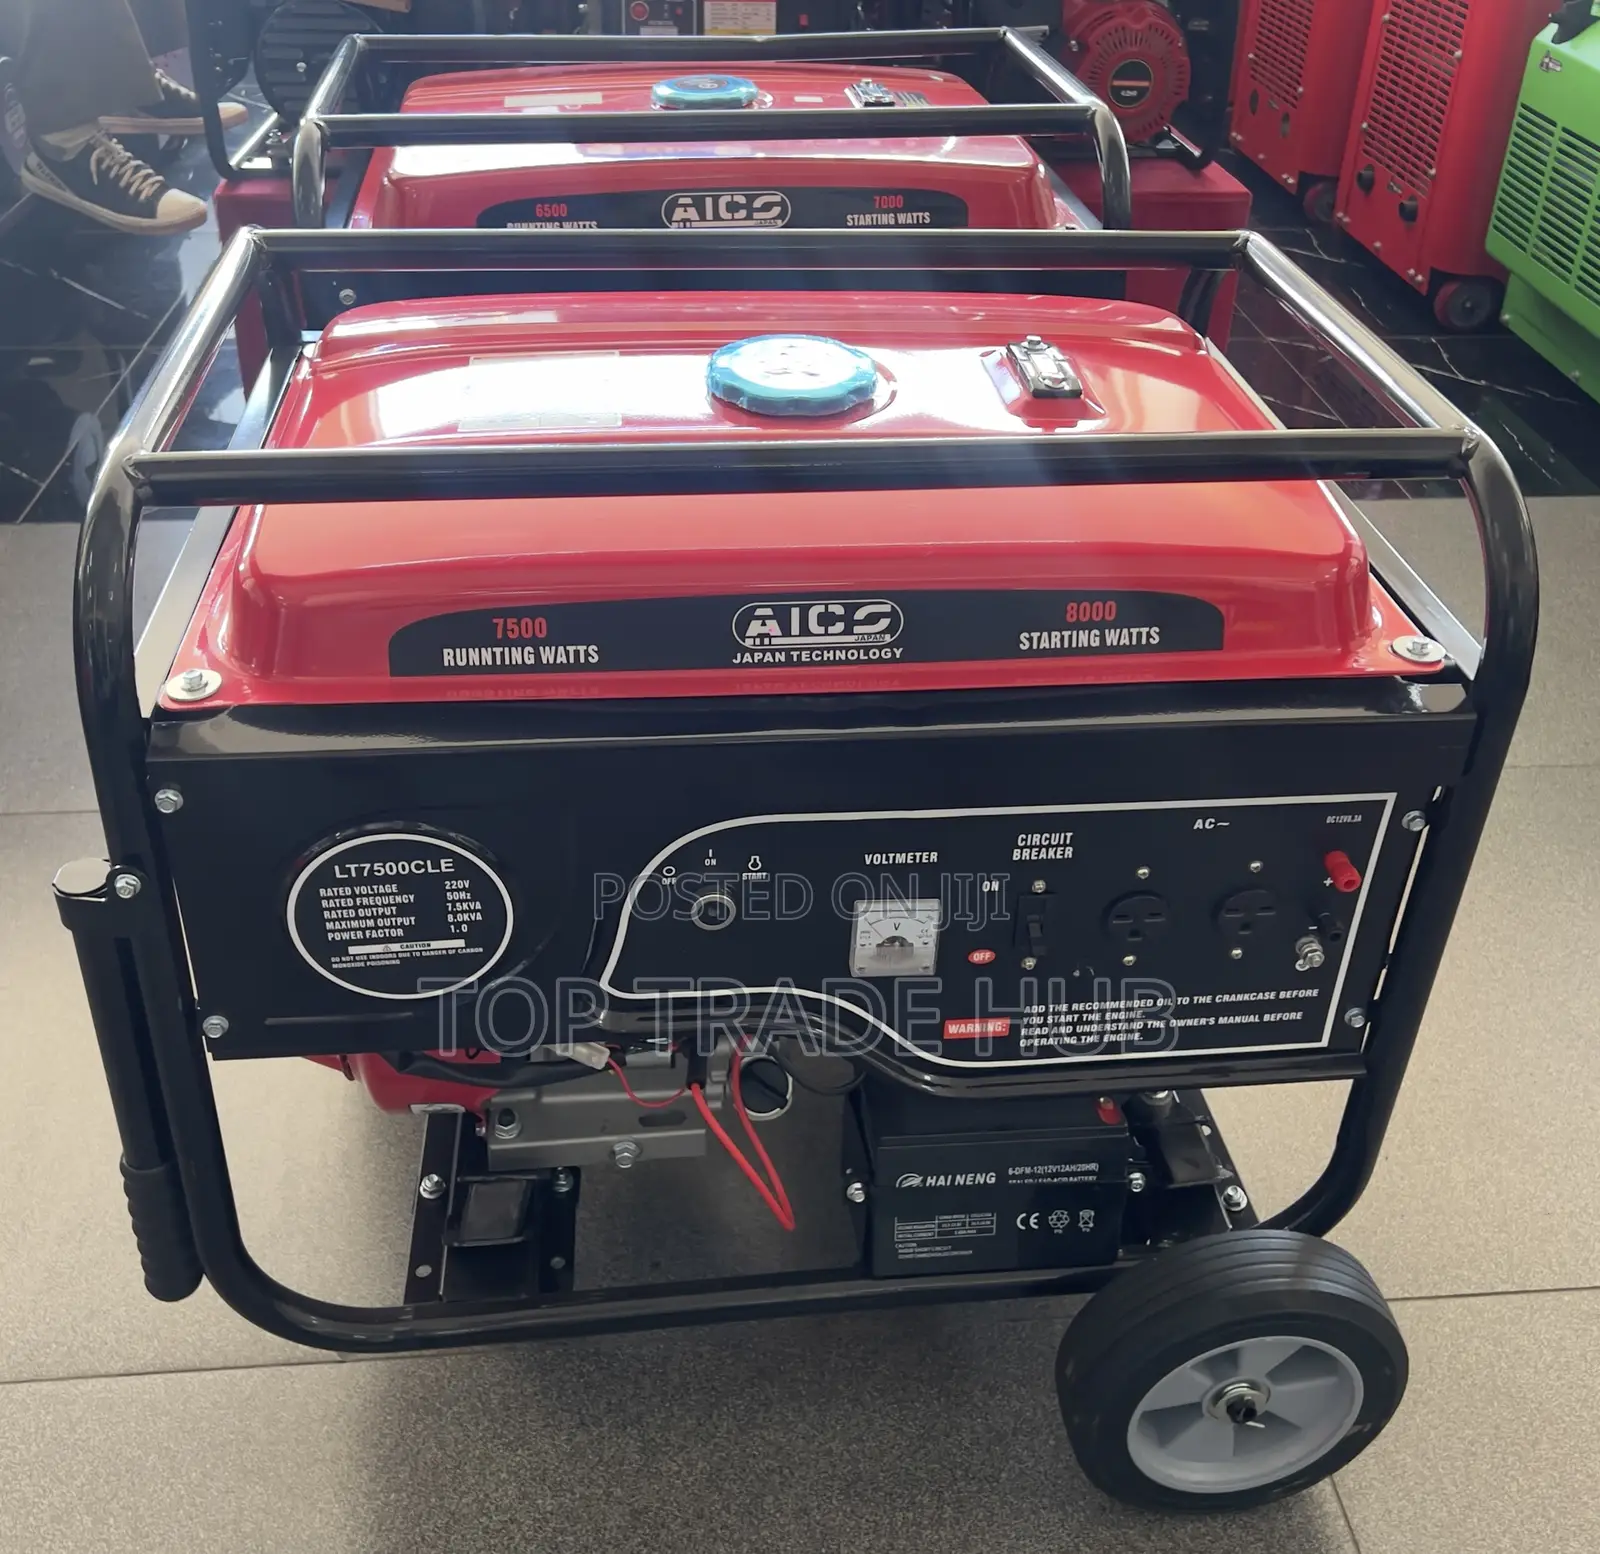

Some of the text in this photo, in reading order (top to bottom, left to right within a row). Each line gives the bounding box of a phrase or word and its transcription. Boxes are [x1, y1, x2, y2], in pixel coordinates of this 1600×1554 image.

[873, 195, 904, 209] 7000
[535, 203, 568, 218] 6500
[846, 212, 931, 226] STARTING WATTS
[1066, 601, 1117, 623] 8000
[492, 617, 548, 640] 7500
[745, 604, 892, 638] AICS
[854, 634, 886, 642] JAPAN
[1019, 626, 1160, 651] STARTING WATTS
[442, 645, 600, 667] RUNNTING WATTS
[732, 648, 904, 664] JAPAN TECHNOLOGY
[1017, 832, 1074, 847] CIRCUIT
[864, 852, 938, 865] VOLTMETER
[1012, 846, 1074, 861] BREAKER
[334, 858, 455, 878] LT7500CLE
[704, 858, 717, 866] ON
[661, 877, 677, 885] OFF
[741, 872, 768, 881] START
[319, 879, 470, 897] RATED VOLTAGE 220V
[981, 880, 1000, 892] ON
[321, 891, 472, 908] RATED FREQUENCY 50Hz
[323, 901, 482, 919] RATED OUTPUT 7.5KVA
[325, 912, 483, 930] MAXIMUM OUTPUT 8.0KVA
[327, 931, 363, 941] POWER
[366, 928, 404, 938] FACTOR
[400, 942, 431, 950] CAUTION
[972, 952, 992, 961] OFF
[1024, 988, 1319, 1014] ADD THE RECOMMENDED OIL TO THE CRANKCASE BEFORE
[1021, 1011, 1303, 1036] READ AND UNDERSTAND THE OWNER'S MANUAL BEFORE
[1022, 1010, 1146, 1025] YOU START THE ENGINE.
[948, 1022, 1007, 1034] WARNING:
[1019, 1032, 1143, 1047] OPERATING THE ENGINE.
[926, 1174, 951, 1187] HAI
[955, 1172, 996, 1185] NENG
